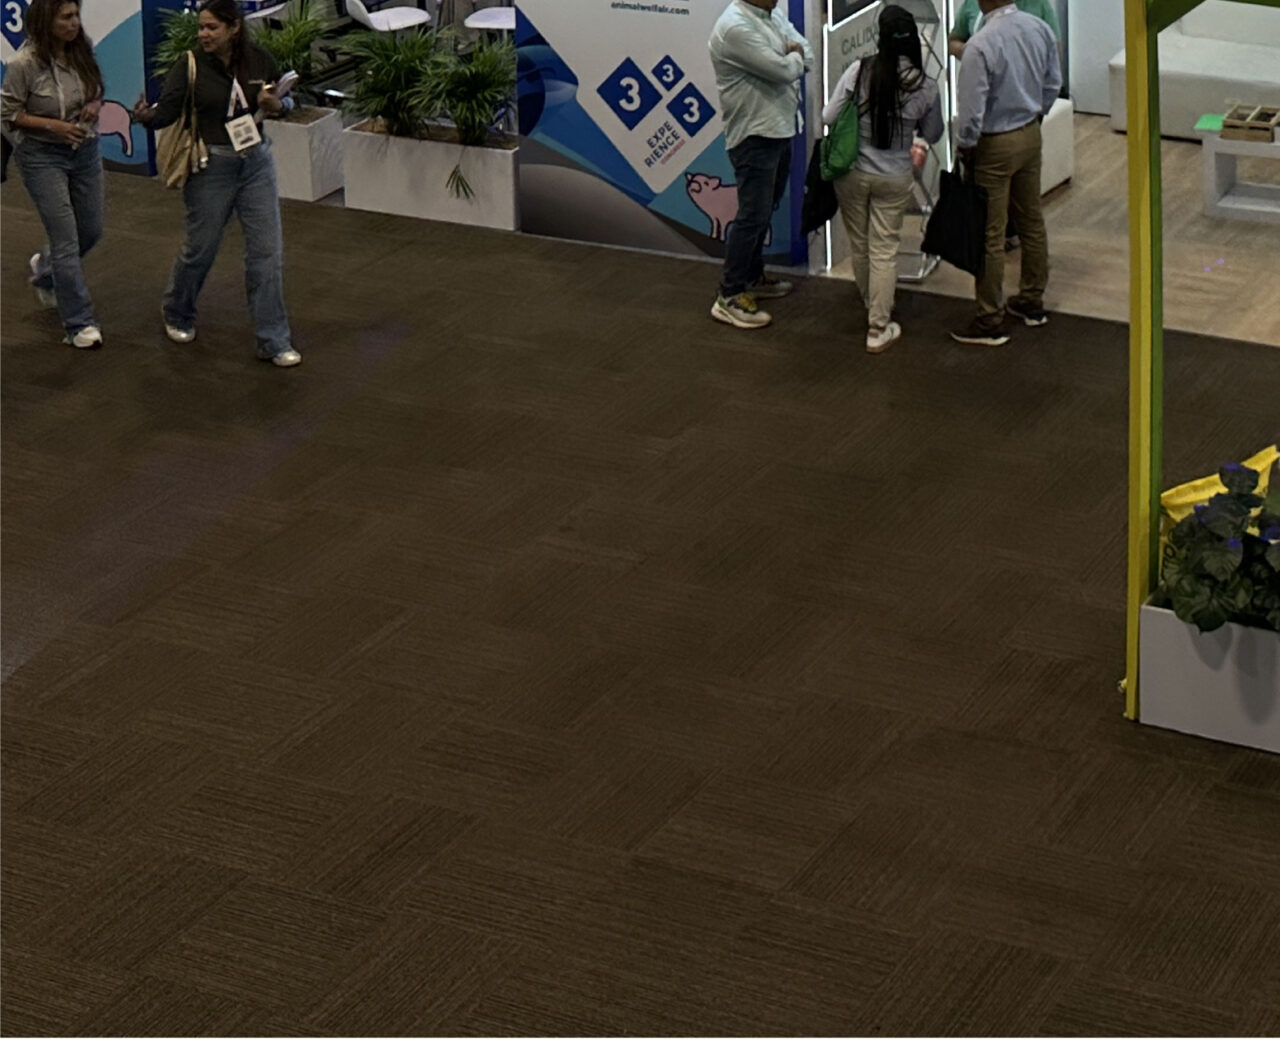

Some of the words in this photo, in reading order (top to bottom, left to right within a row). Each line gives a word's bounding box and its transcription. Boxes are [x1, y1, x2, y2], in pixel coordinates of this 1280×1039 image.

[6, 2, 23, 33] 3
[611, 0, 690, 15] animalwelfair.com
[618, 76, 641, 112] 3
[662, 63, 676, 83] 3
[683, 104, 700, 124] 3
[645, 130, 680, 168] RIENCE
[647, 121, 672, 148] EXPE
